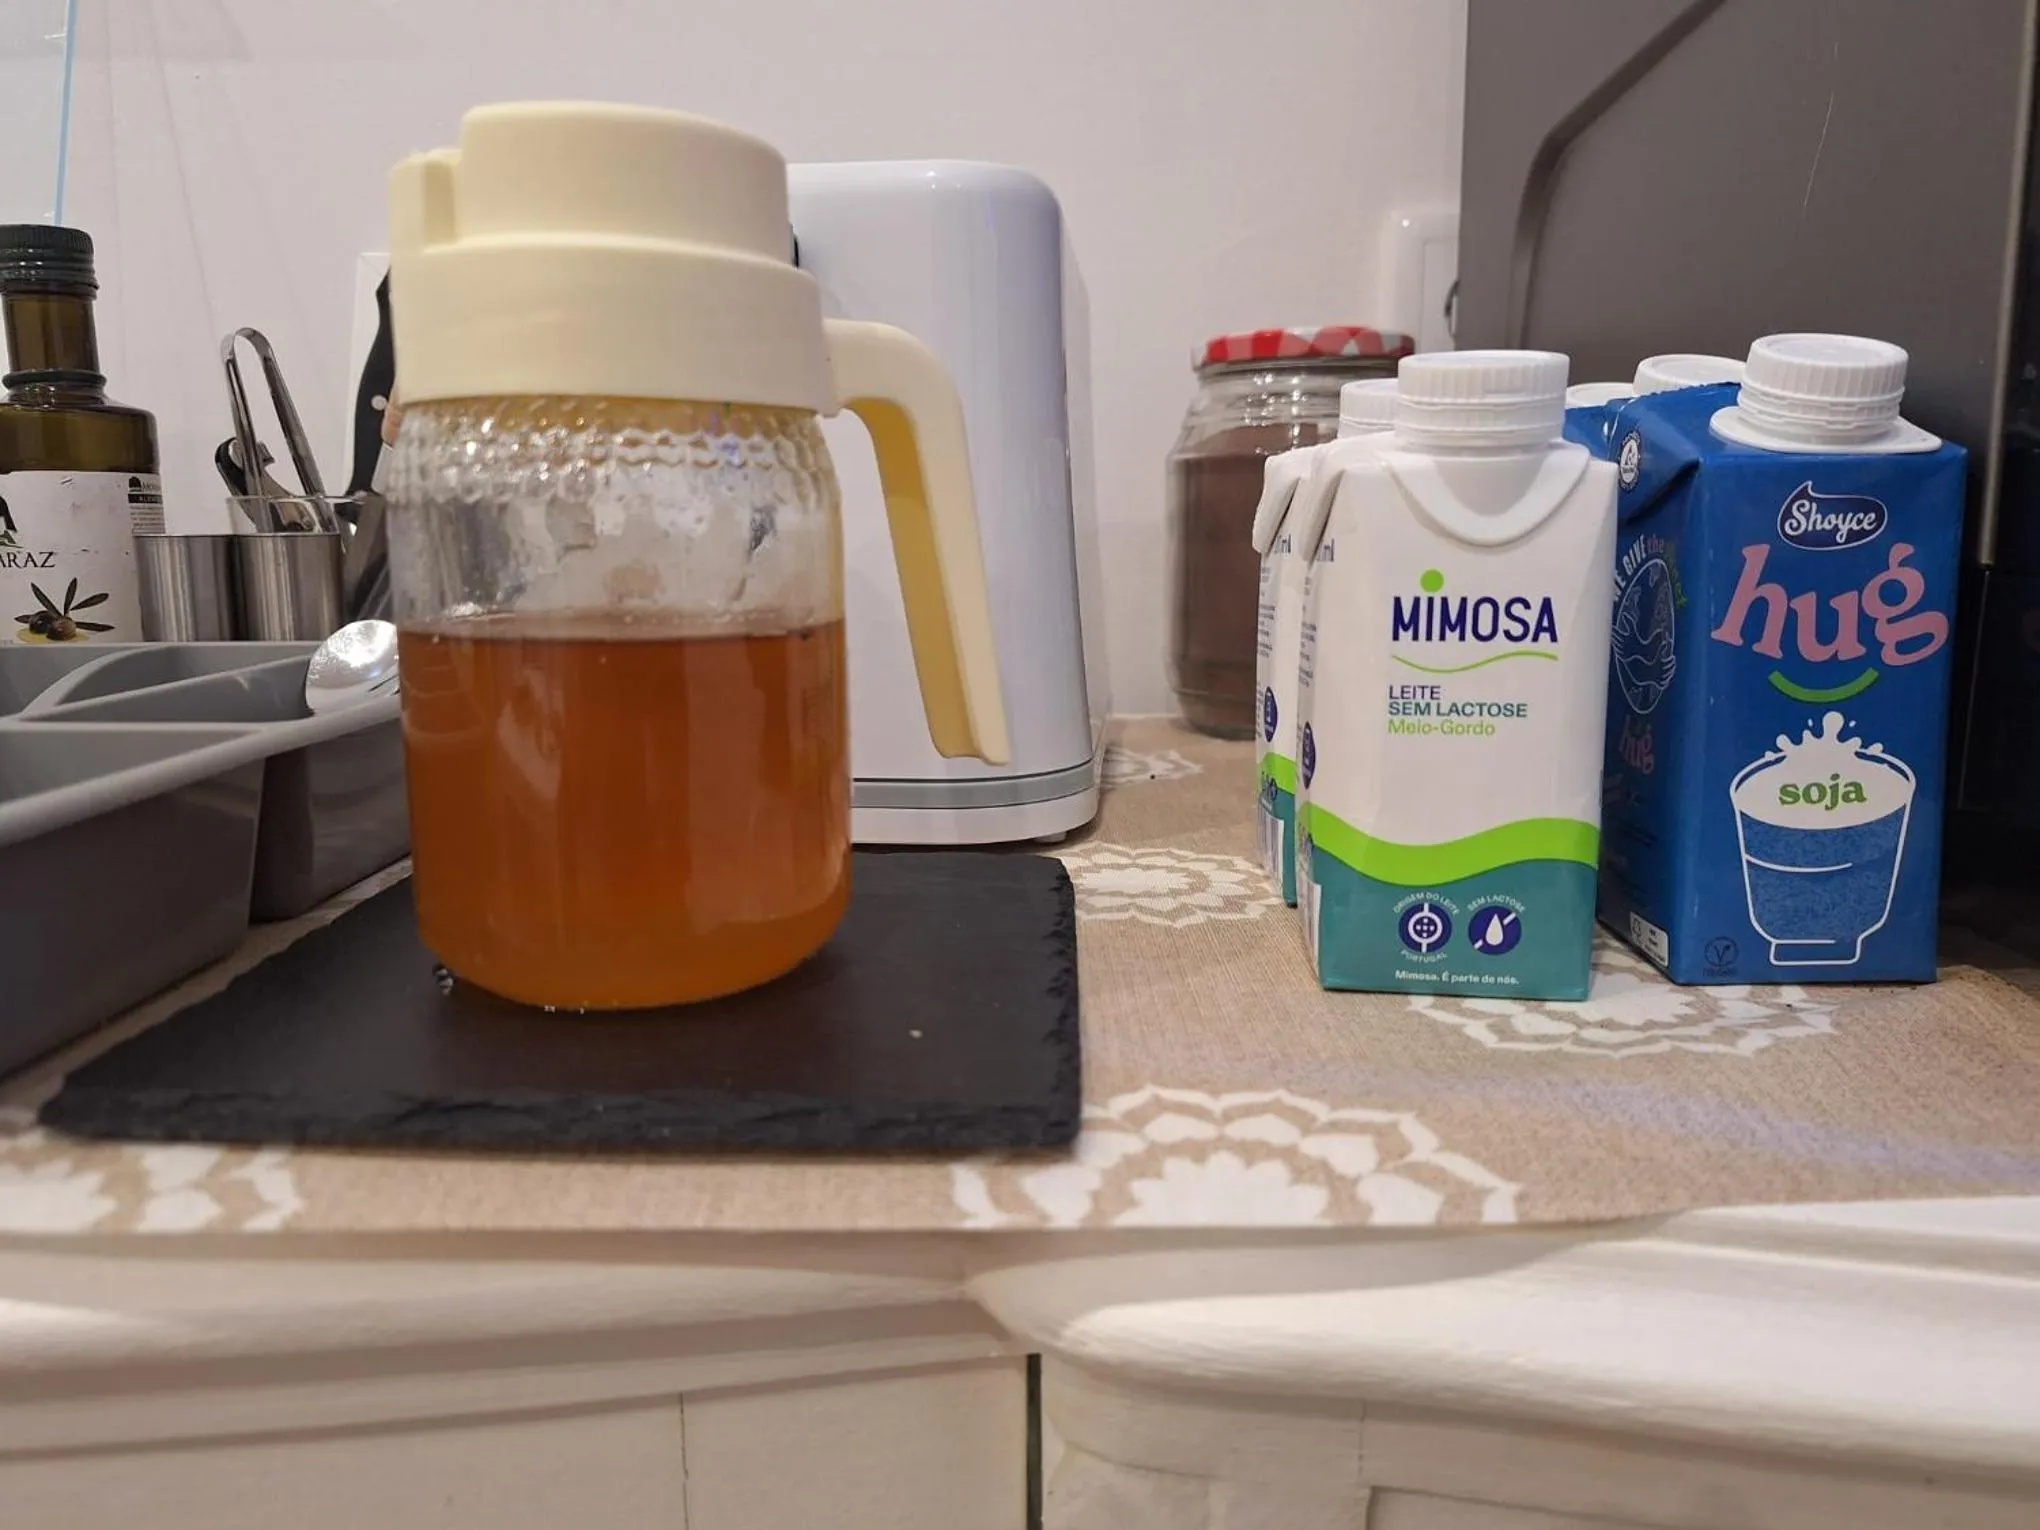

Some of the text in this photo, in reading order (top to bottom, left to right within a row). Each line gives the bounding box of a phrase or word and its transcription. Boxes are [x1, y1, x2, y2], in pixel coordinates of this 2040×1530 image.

[1784, 500, 1877, 544] Shoyce
[1711, 542, 1950, 666] hug
[1391, 595, 1559, 643] MIMOSA
[1388, 684, 1442, 701] LEITE
[1388, 701, 1529, 718] SEM LACTOSE
[1387, 719, 1496, 736] Meio-Gordo
[1778, 773, 1867, 811] soja
[1451, 974, 1480, 984] parte
[1481, 974, 1496, 984] de
